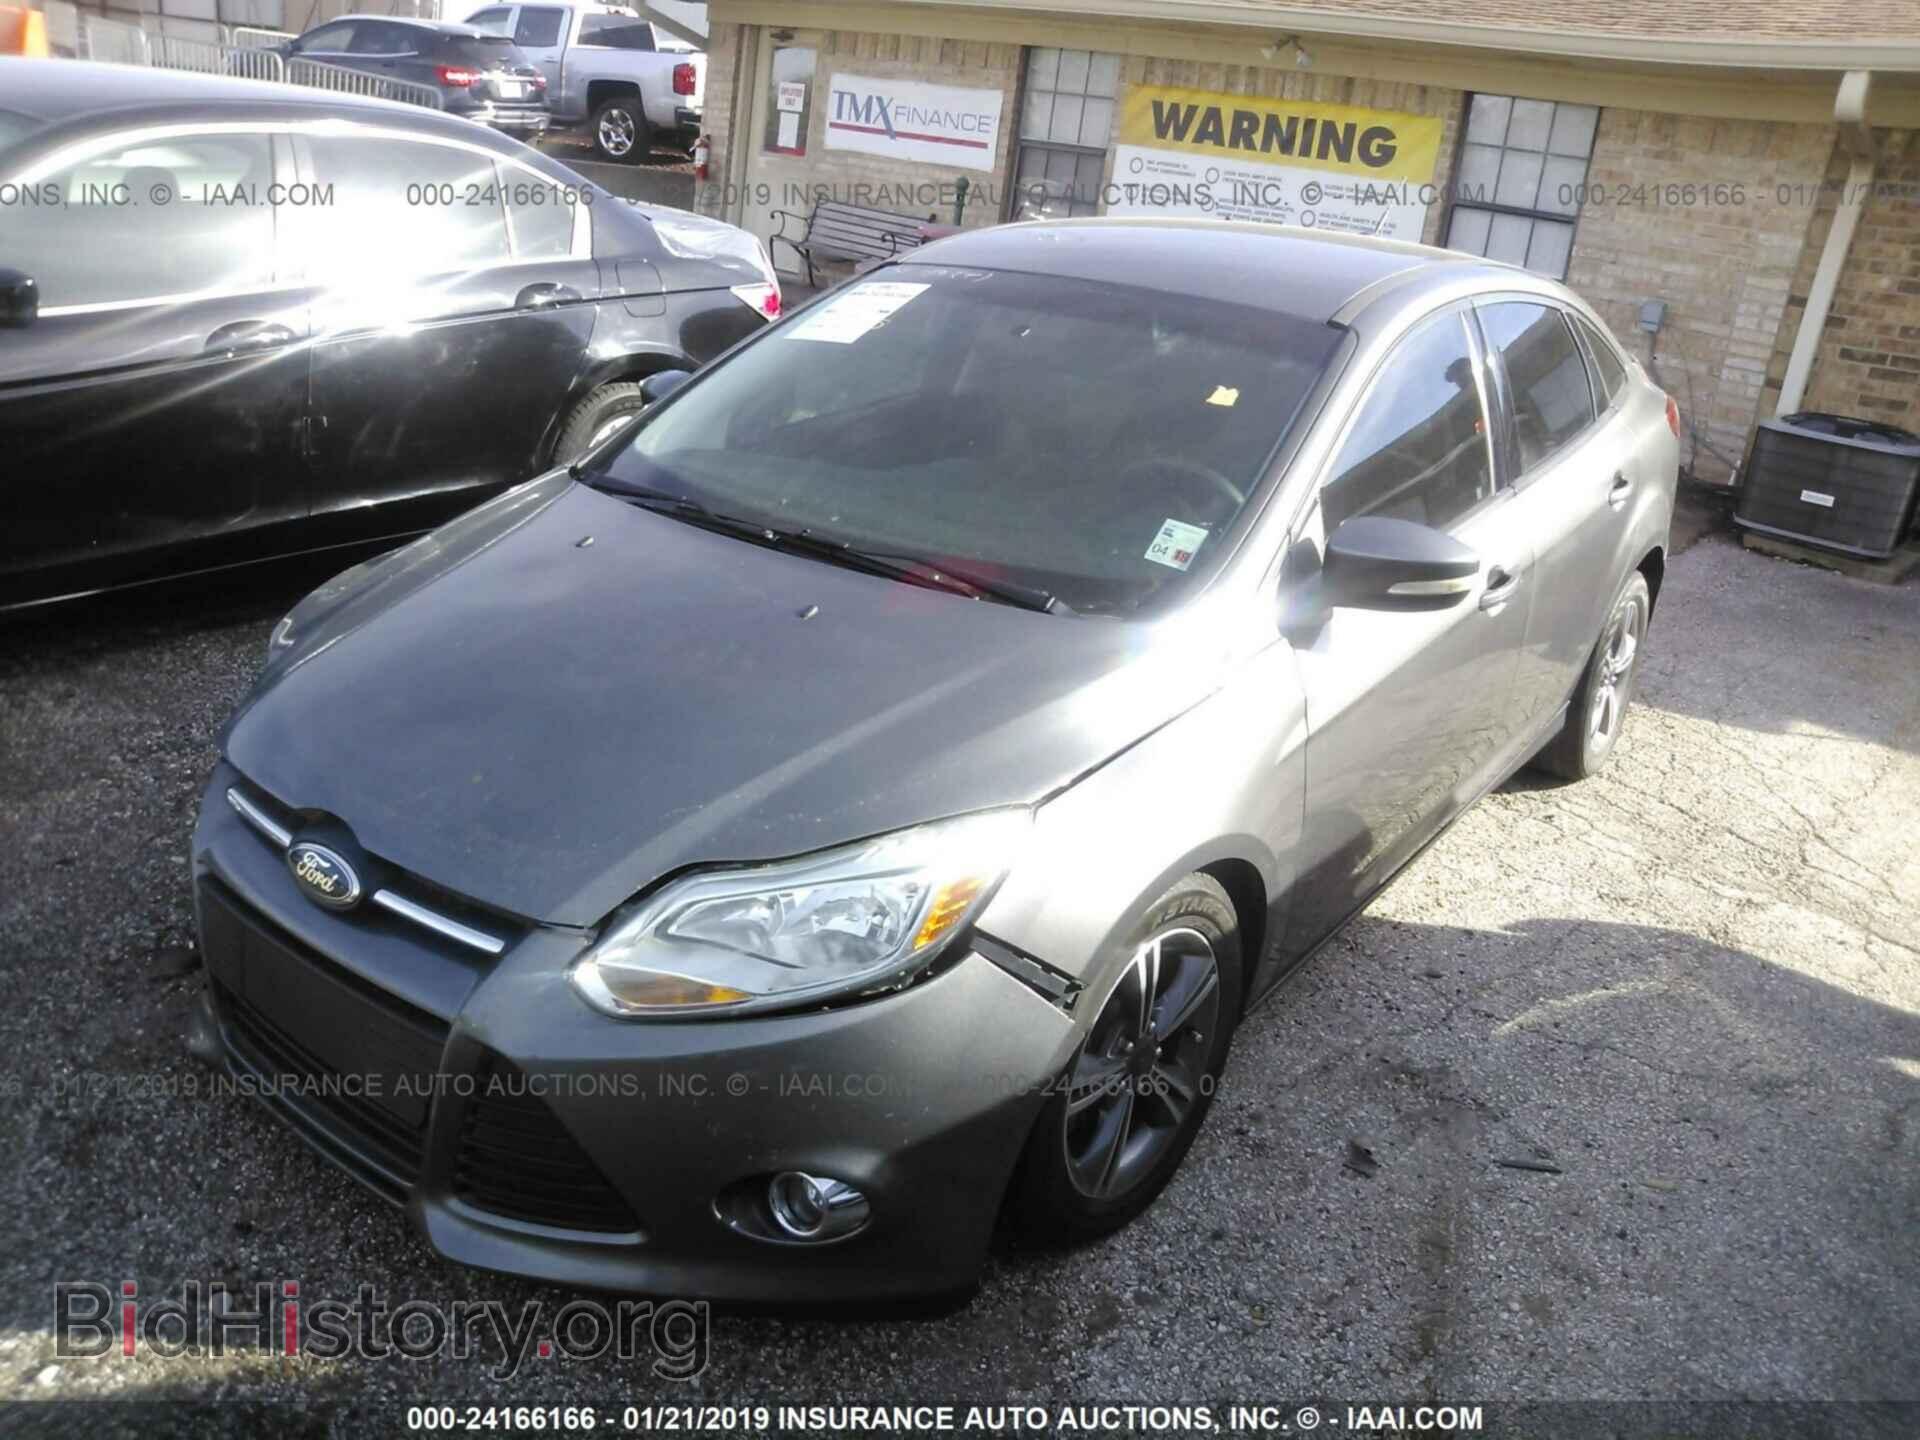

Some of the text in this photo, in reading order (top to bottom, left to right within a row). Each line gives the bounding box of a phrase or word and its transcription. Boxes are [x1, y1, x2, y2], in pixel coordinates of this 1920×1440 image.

[833, 90, 991, 140] TMX FINANCE
[1152, 100, 1397, 168] WARNING
[297, 852, 339, 892] Ford
